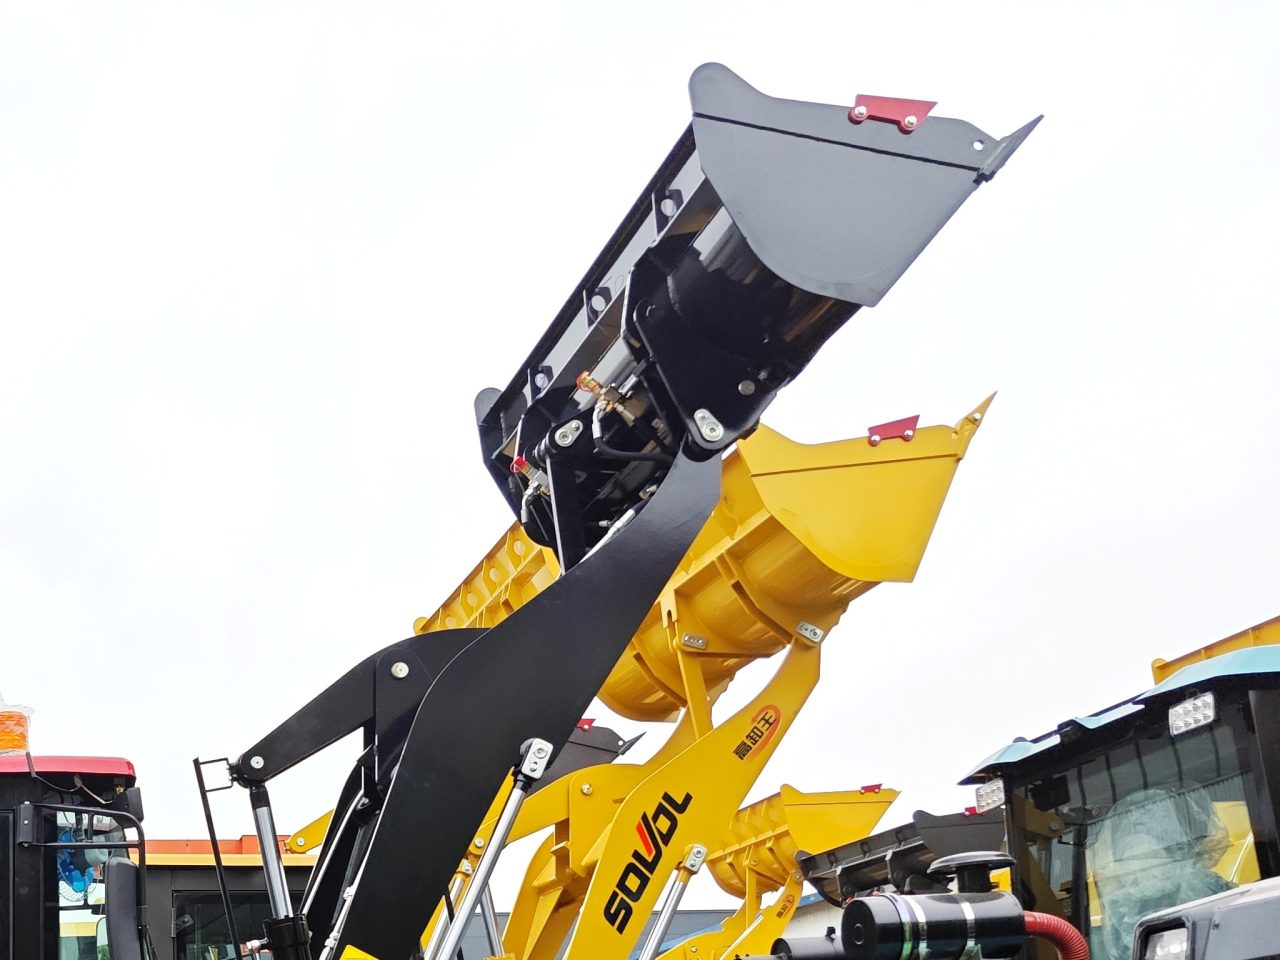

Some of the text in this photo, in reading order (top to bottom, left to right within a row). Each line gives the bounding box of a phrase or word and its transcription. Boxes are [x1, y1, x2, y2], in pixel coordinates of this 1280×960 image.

[733, 711, 777, 760] 高卸王
[603, 791, 693, 935] SOVOL
